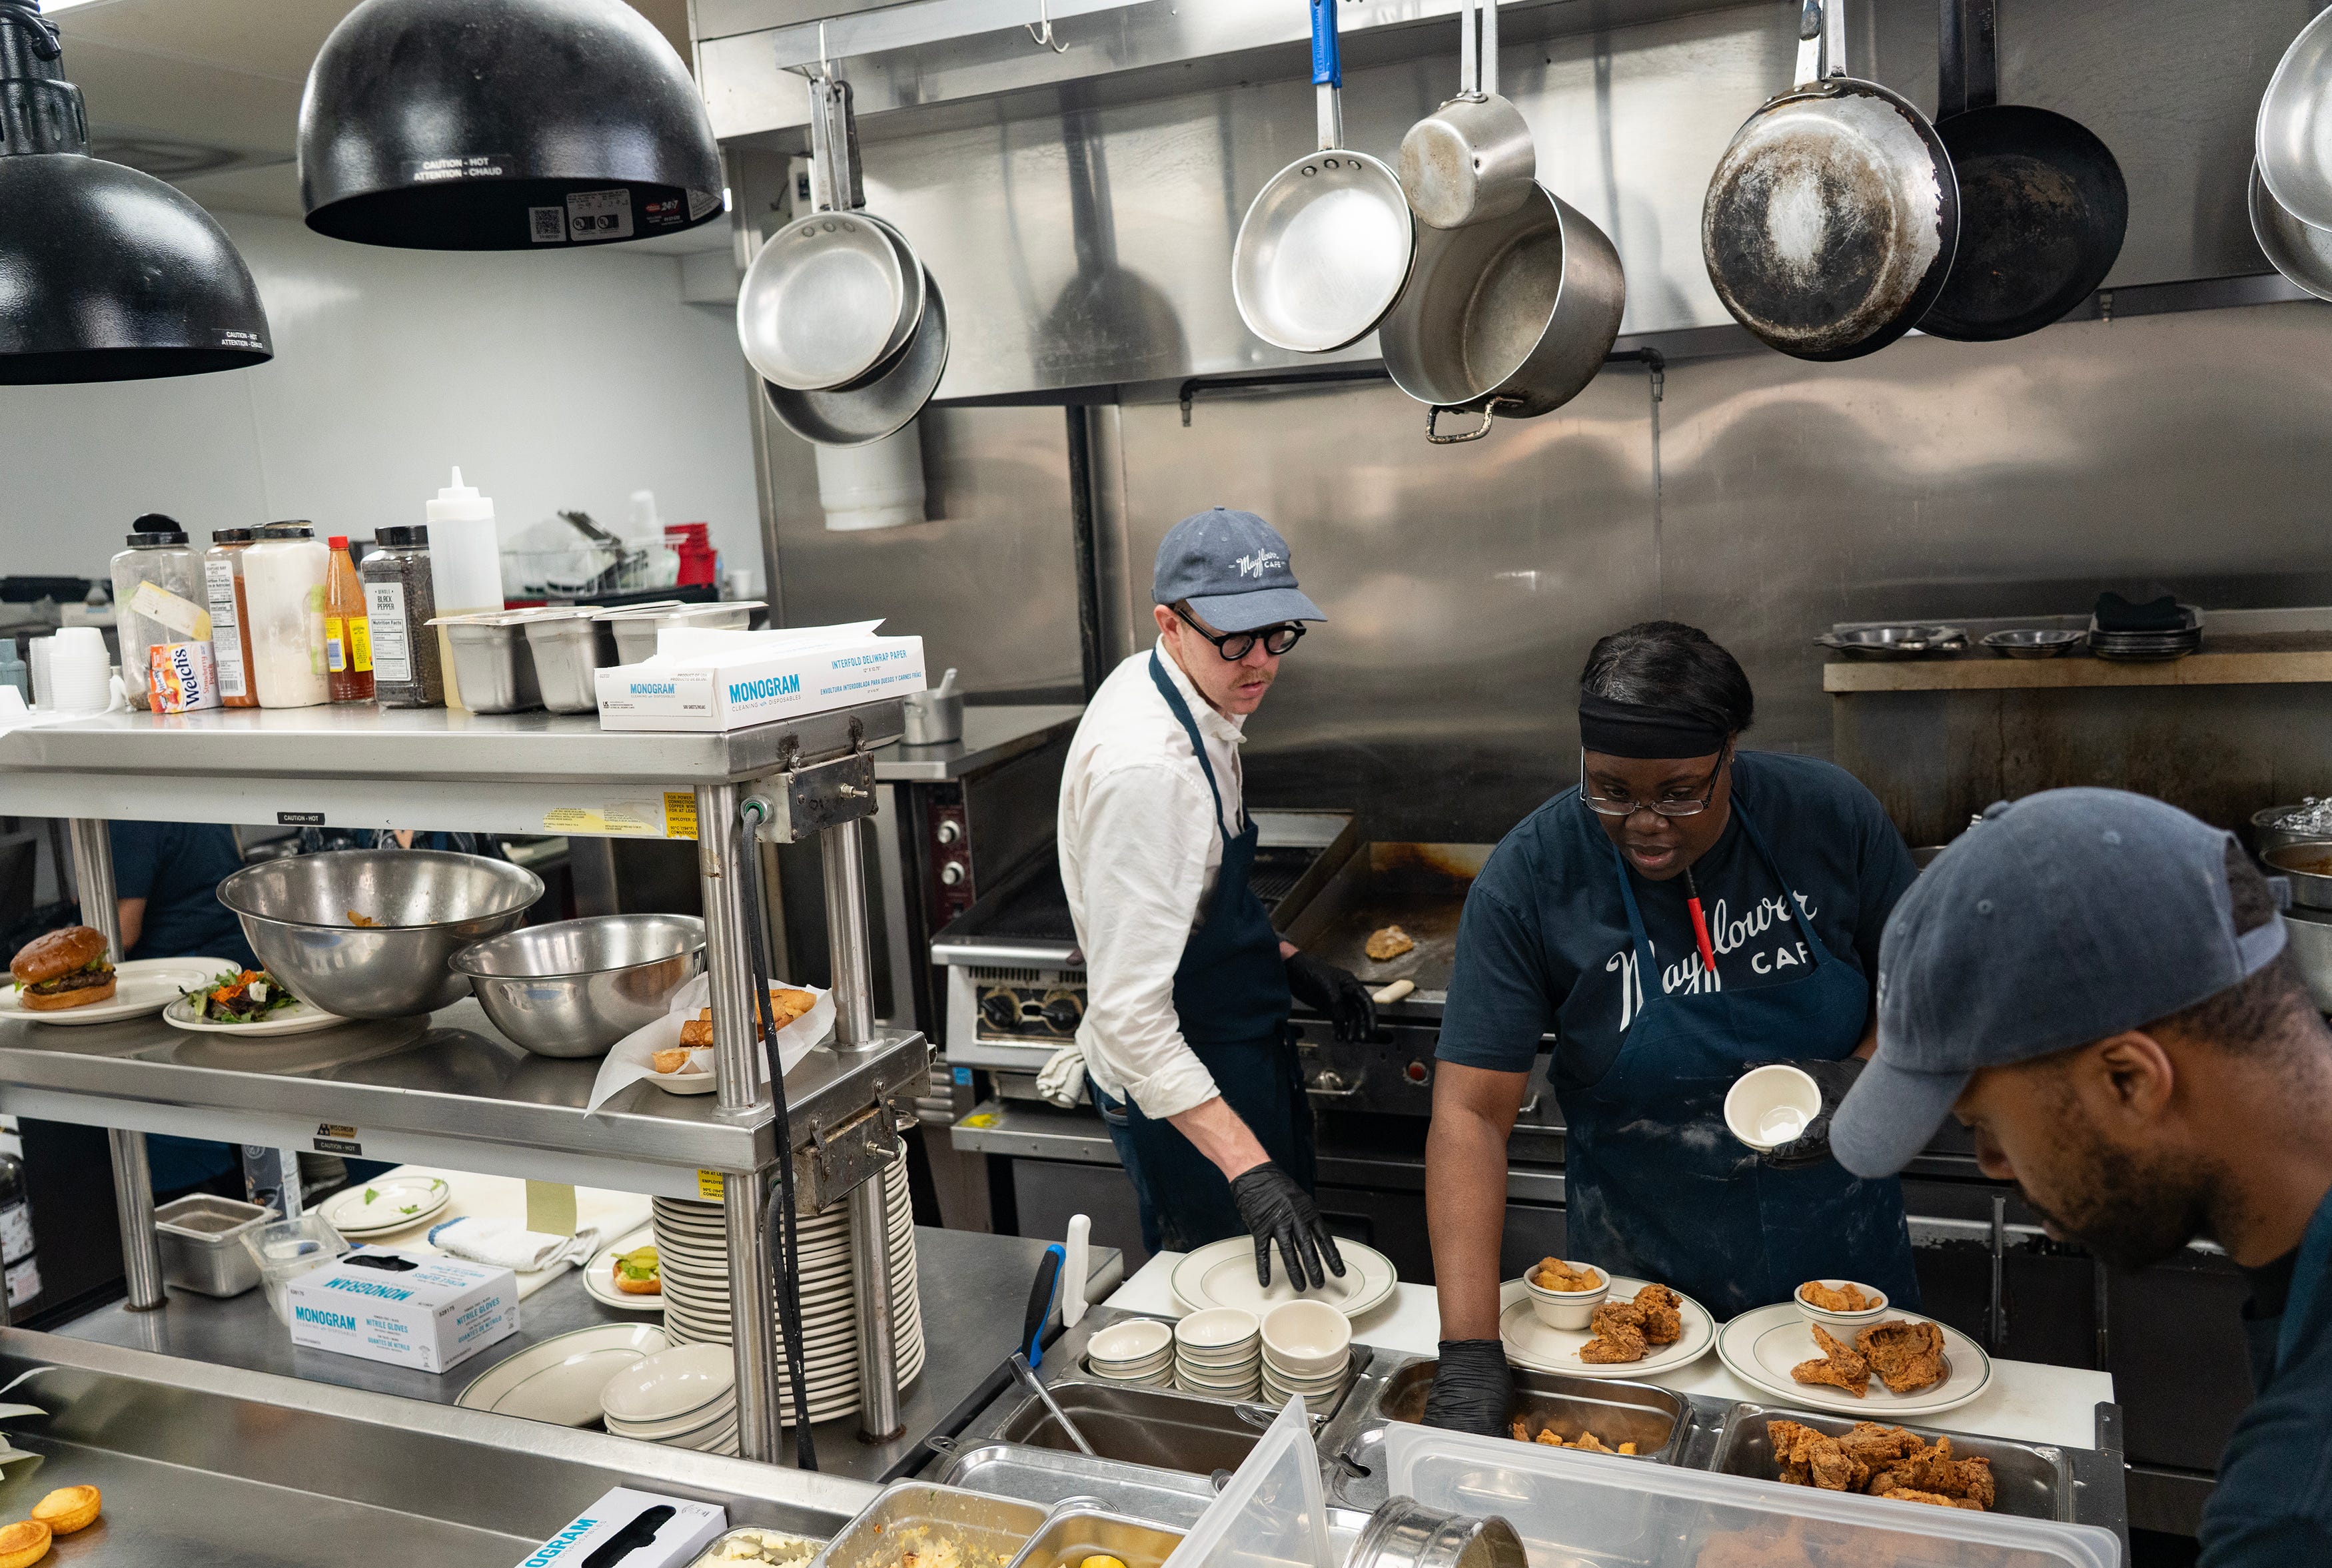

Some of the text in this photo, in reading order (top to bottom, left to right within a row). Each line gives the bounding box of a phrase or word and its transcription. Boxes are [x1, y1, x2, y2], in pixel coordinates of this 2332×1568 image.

[414, 167, 502, 181] ATTENTION CHAUD
[423, 159, 462, 170] CAUTION
[832, 649, 907, 669] INTERFOLD DELIWRAP PAPER
[174, 649, 200, 707] Welch's
[630, 683, 675, 694] MONOGRAM
[729, 673, 800, 703] MONOGRAM
[820, 685, 842, 695] ENVOLTURA
[843, 681, 870, 691] INTERDOBLADA
[881, 676, 895, 685] QUESOS
[732, 702, 758, 711] CLEANING
[769, 694, 802, 705] DISPOSABLES
[1752, 942, 1808, 974] CAF
[324, 1278, 414, 1301] MONOGRAM
[295, 1306, 356, 1331] MONOGRAM
[456, 1308, 478, 1326] NITRILE
[479, 1297, 500, 1314] GLOVES
[366, 1318, 386, 1329] NITRILE
[387, 1323, 408, 1333] GLOVES
[525, 1518, 598, 1568] OGRAM
